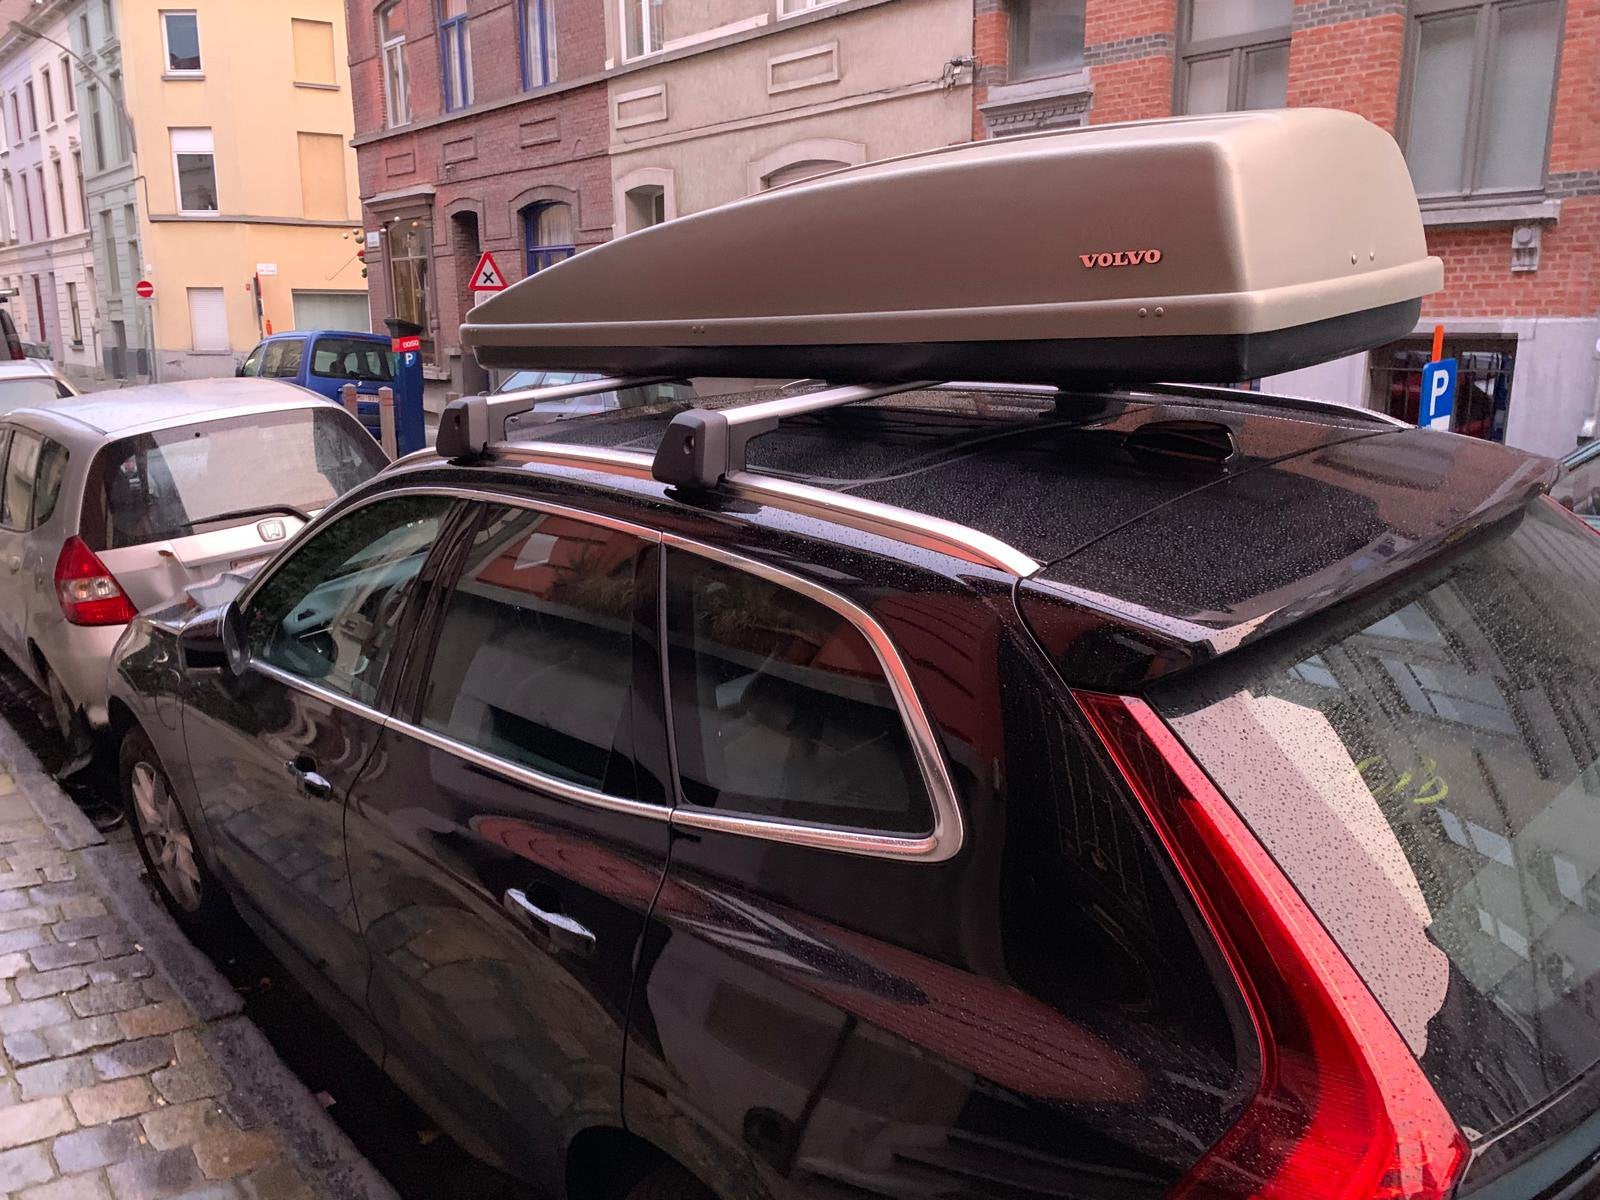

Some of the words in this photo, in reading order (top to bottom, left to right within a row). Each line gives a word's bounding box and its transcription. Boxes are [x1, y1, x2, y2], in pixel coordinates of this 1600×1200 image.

[1079, 249, 1162, 269] VOLVO
[405, 352, 414, 365] P
[1429, 369, 1450, 417] P
